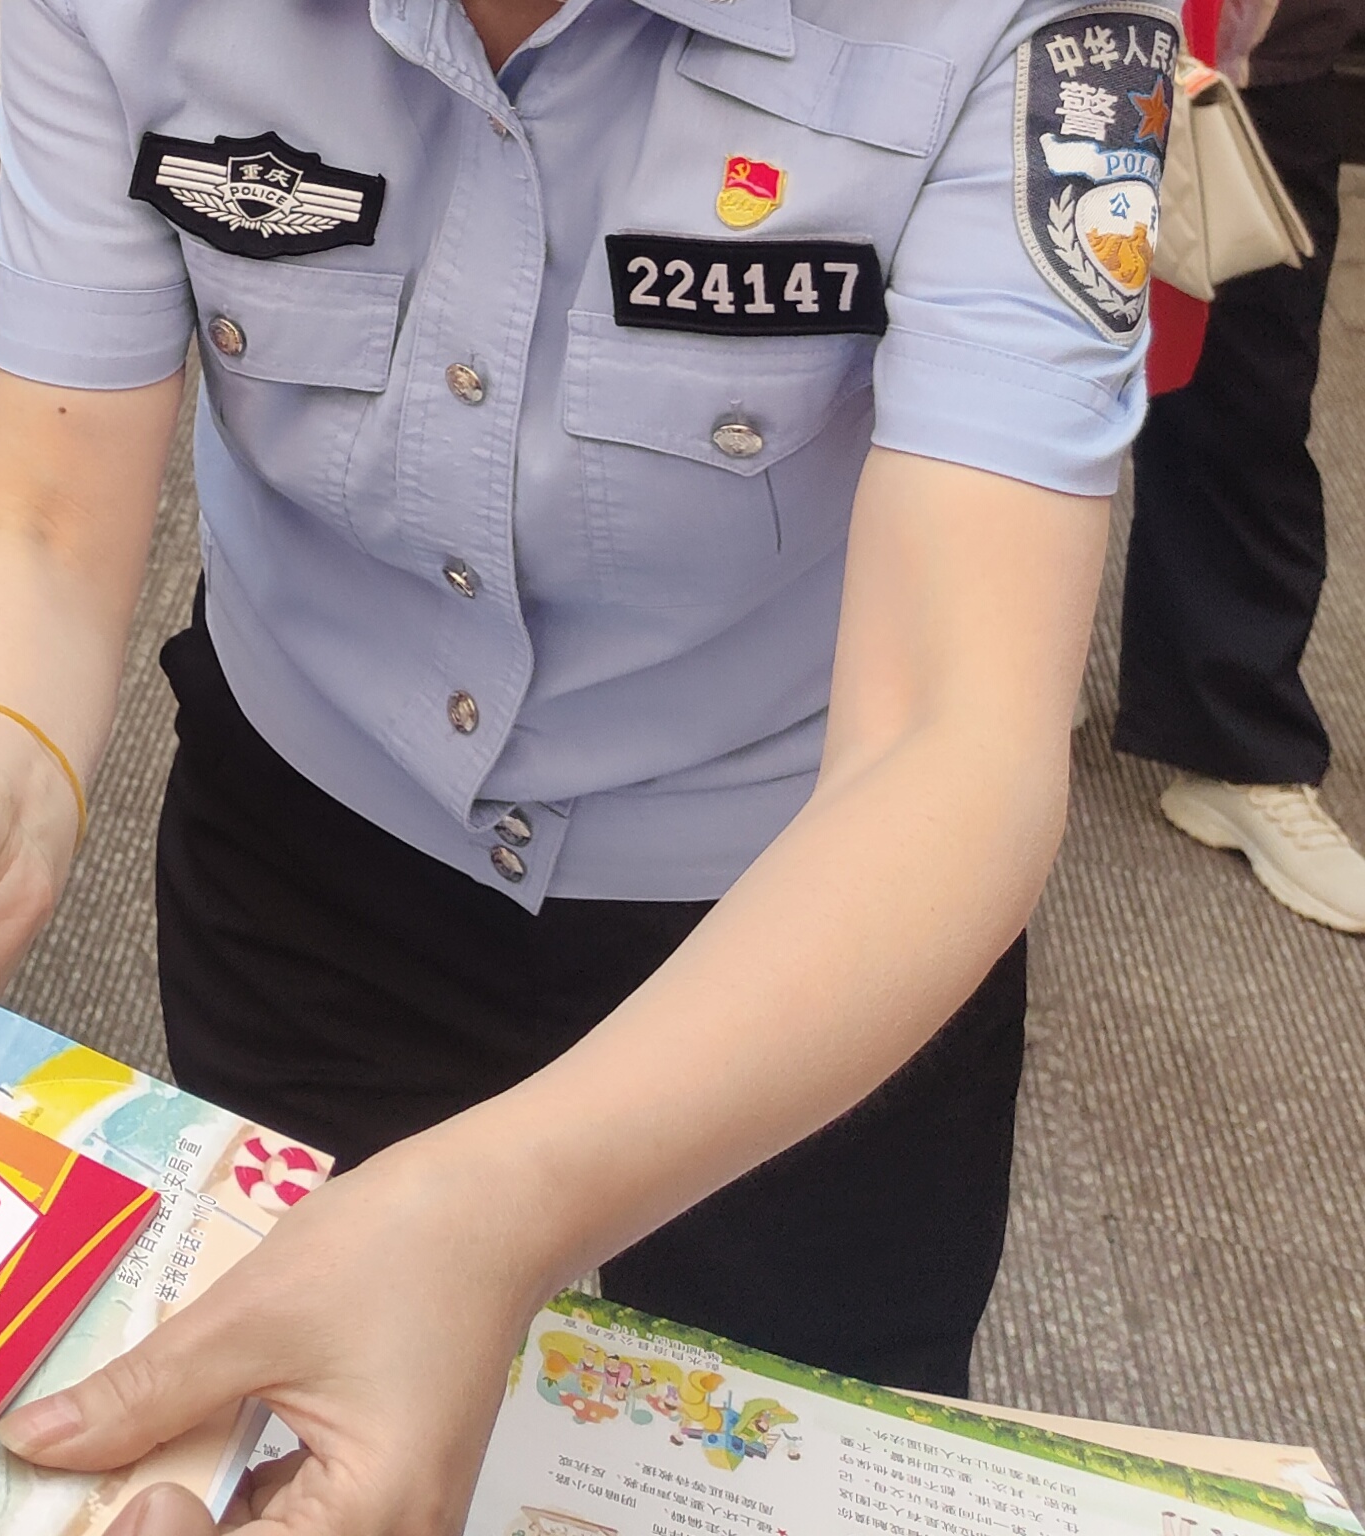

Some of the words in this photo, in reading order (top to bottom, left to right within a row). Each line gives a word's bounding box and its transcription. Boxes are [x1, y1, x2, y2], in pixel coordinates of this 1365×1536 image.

[239, 164, 291, 187] 重庆
[230, 186, 288, 205] POLICE
[626, 255, 860, 314] 224147
